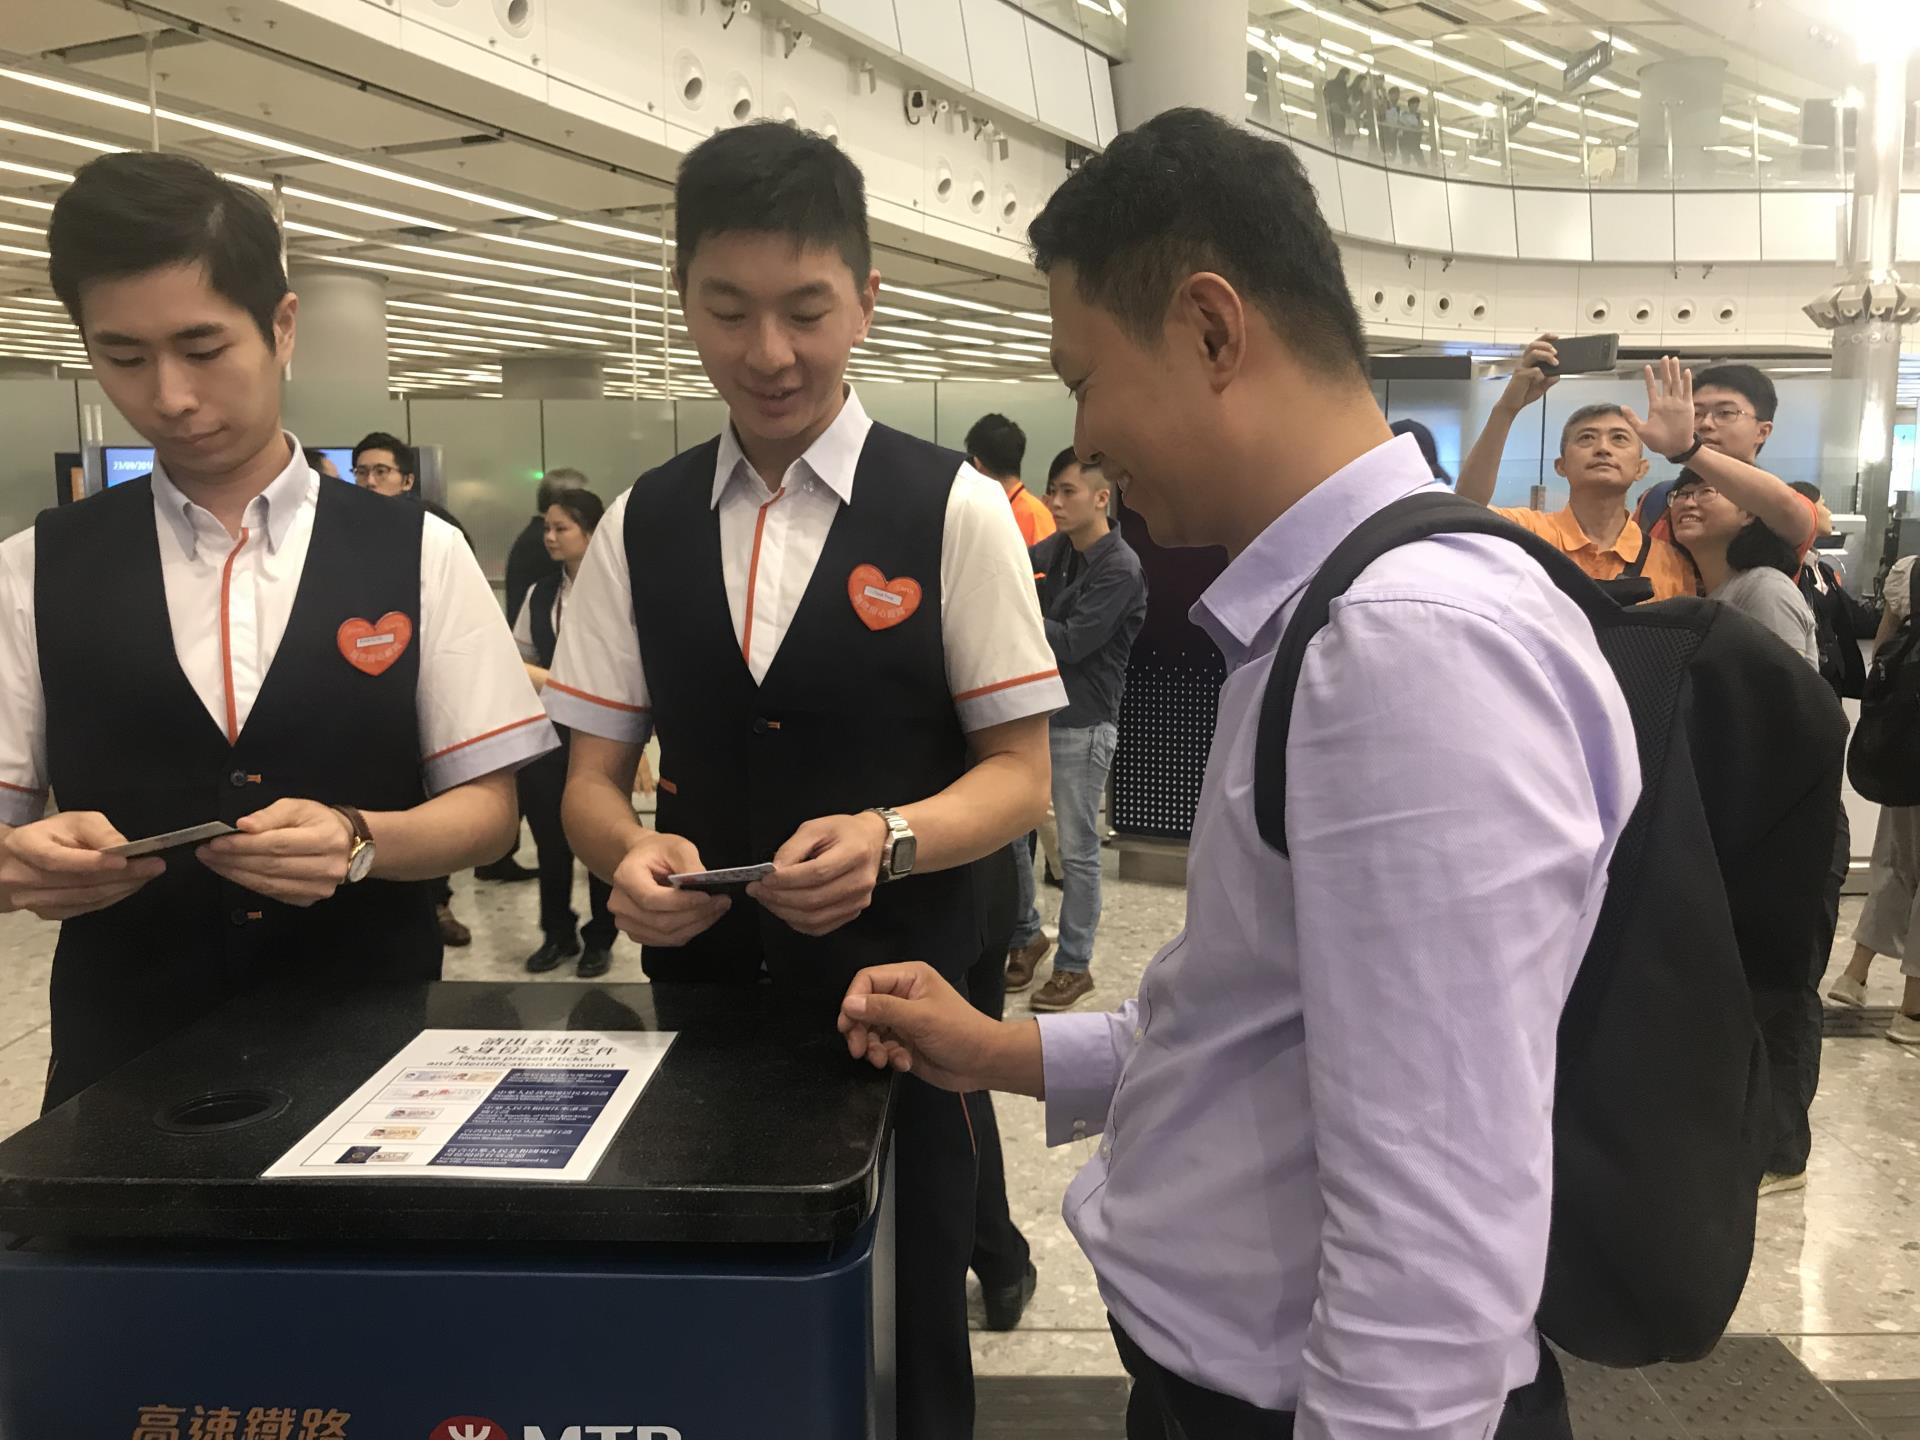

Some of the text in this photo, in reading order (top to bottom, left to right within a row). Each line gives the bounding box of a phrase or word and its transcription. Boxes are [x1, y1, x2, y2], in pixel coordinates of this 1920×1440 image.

[449, 1046, 618, 1055] 及身份證明文件
